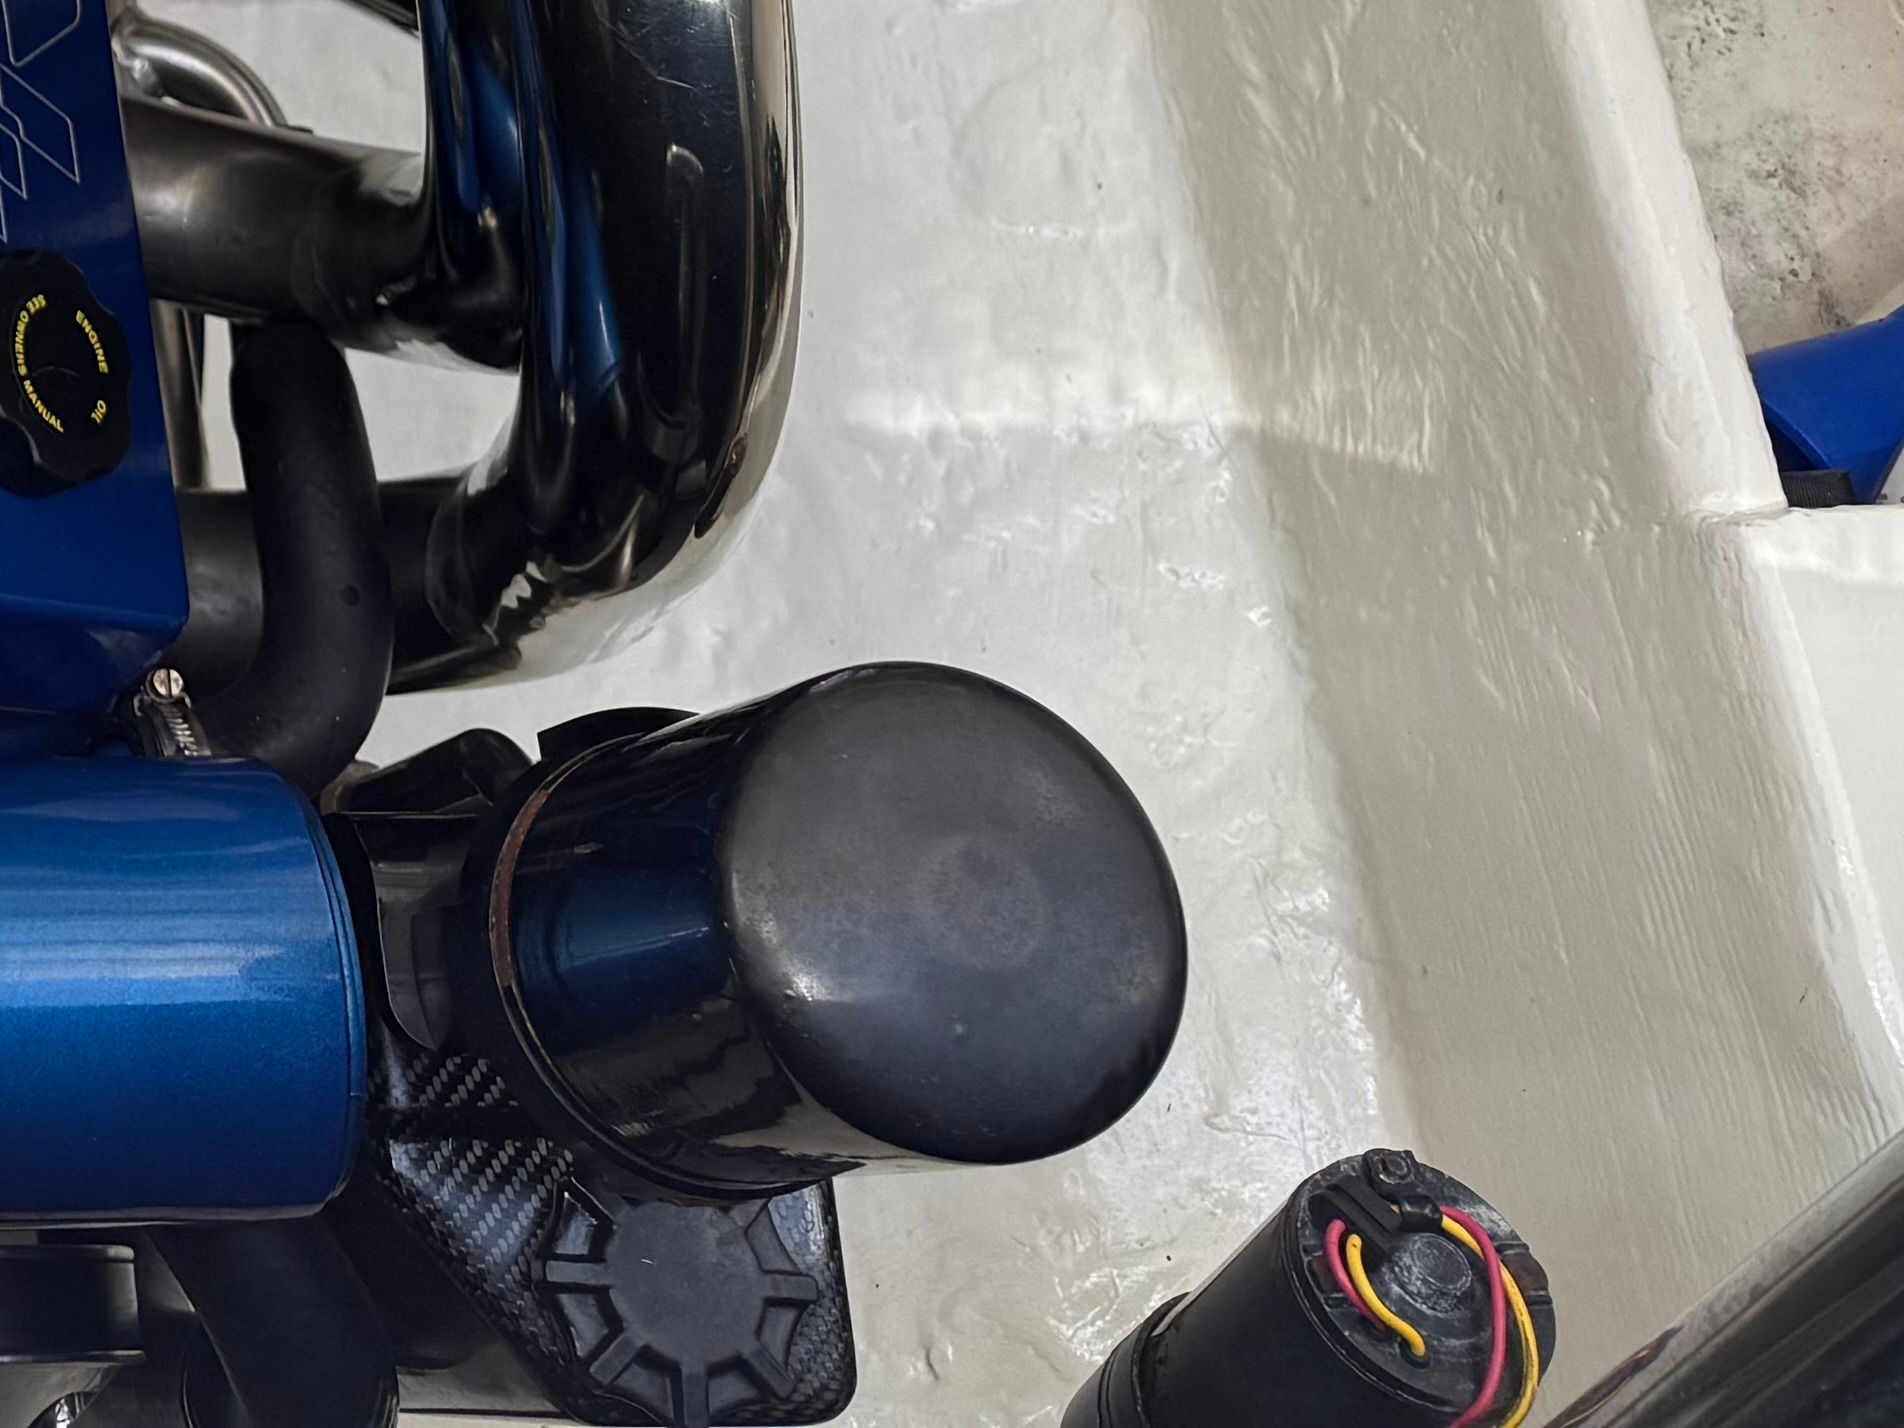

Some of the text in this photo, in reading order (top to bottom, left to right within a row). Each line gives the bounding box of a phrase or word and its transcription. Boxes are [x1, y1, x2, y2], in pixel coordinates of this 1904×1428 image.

[15, 294, 64, 433] SEE OWNERS MANUAL
[76, 310, 109, 424] ENGINE OIL
